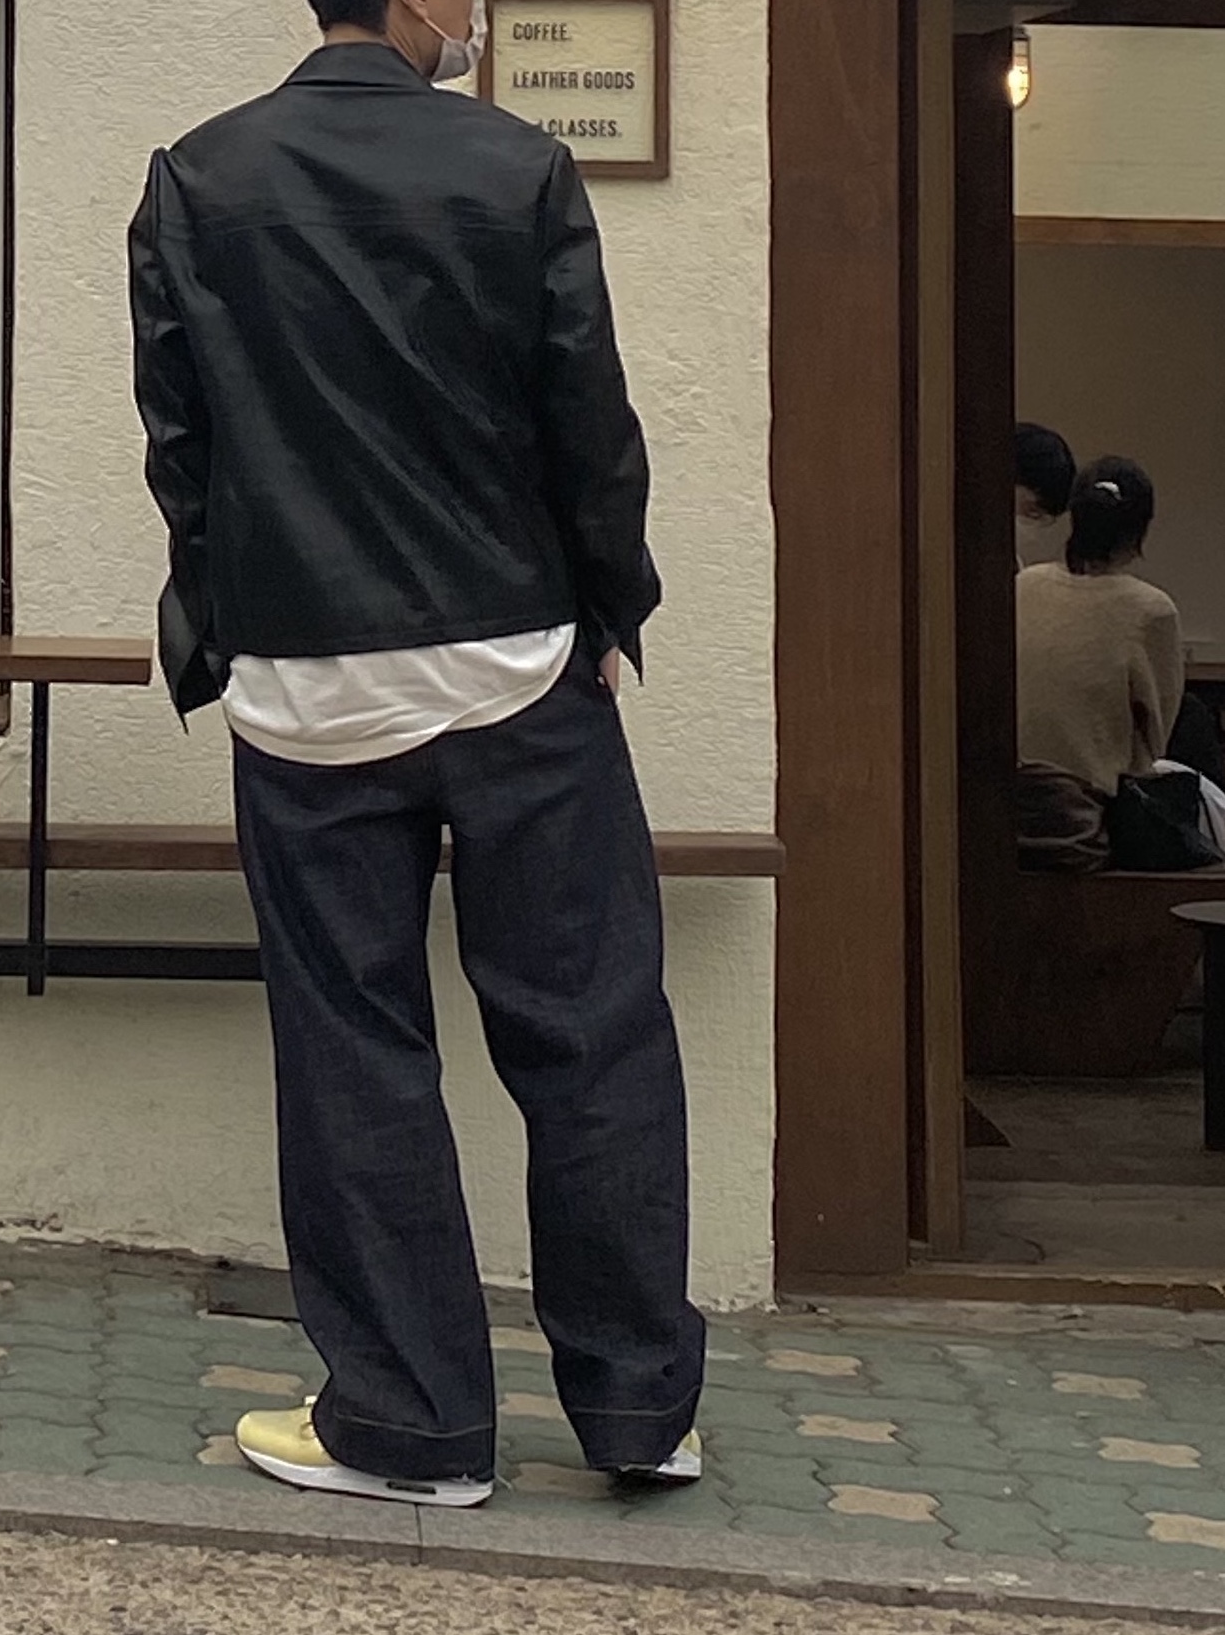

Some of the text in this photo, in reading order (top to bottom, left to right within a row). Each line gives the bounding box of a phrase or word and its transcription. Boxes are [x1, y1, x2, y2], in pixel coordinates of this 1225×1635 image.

[512, 22, 572, 42] COFFEE.
[512, 71, 635, 90] LEATHER GOODS
